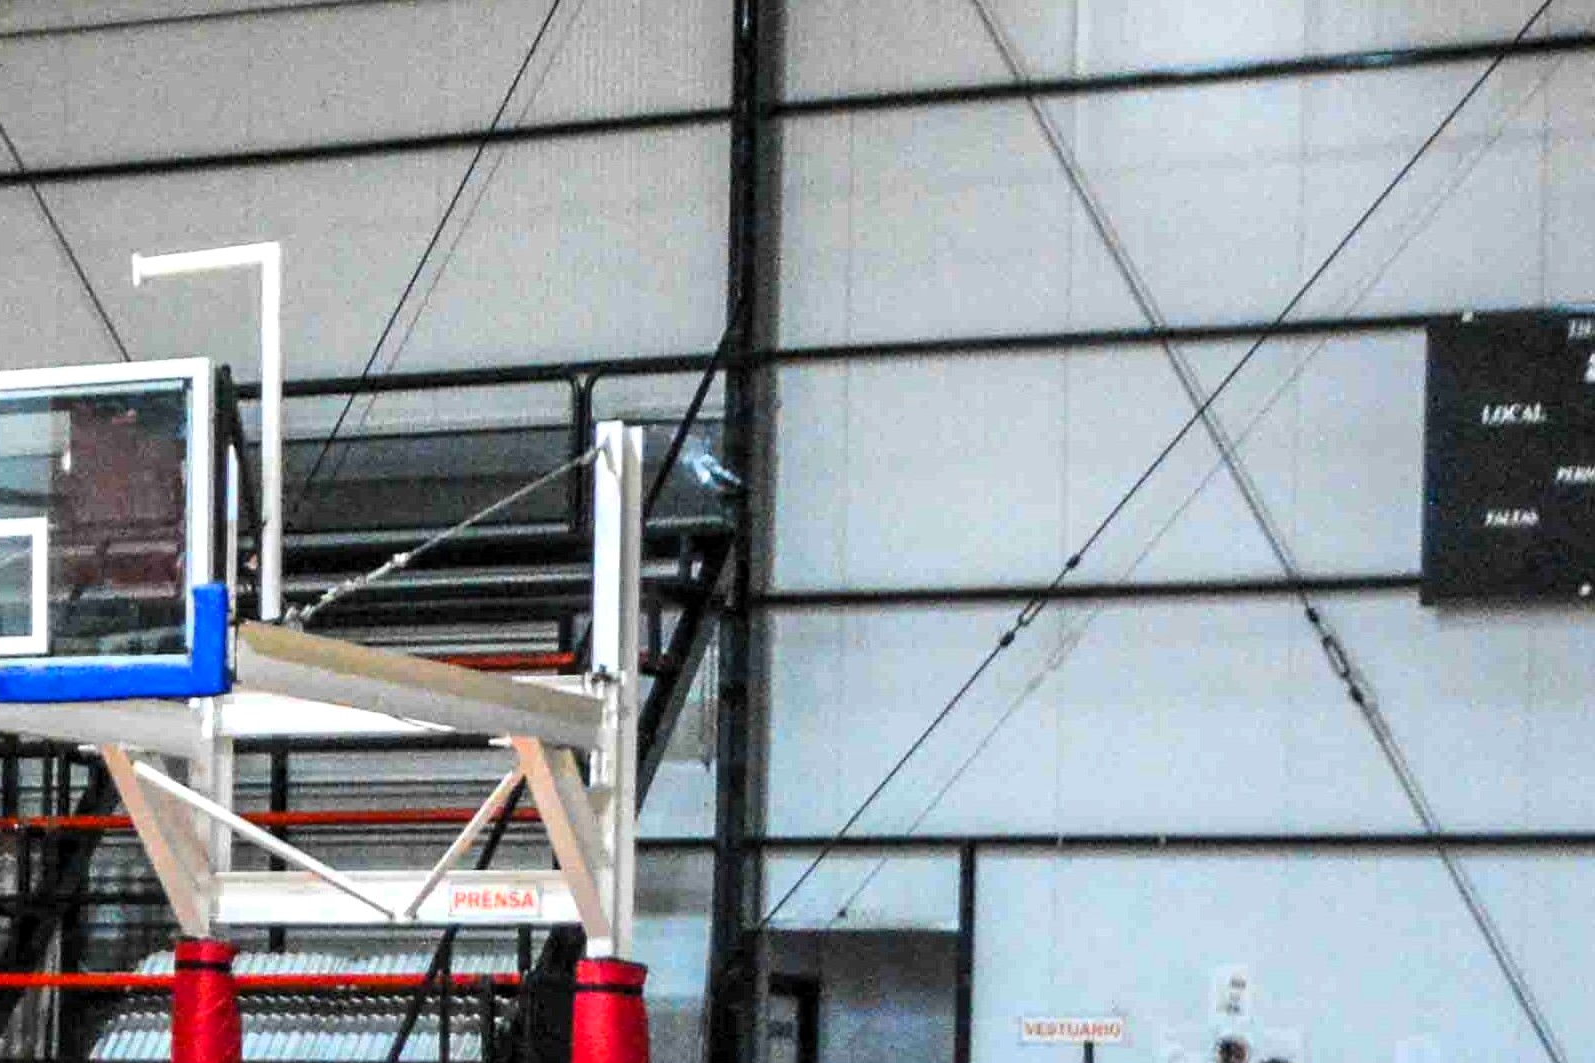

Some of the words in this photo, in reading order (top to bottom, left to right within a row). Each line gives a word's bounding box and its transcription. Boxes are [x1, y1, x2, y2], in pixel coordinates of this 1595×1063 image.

[1481, 402, 1546, 425] LOCAL
[453, 890, 534, 909] PRENSA
[1023, 1022, 1121, 1038] VESTUARIO
